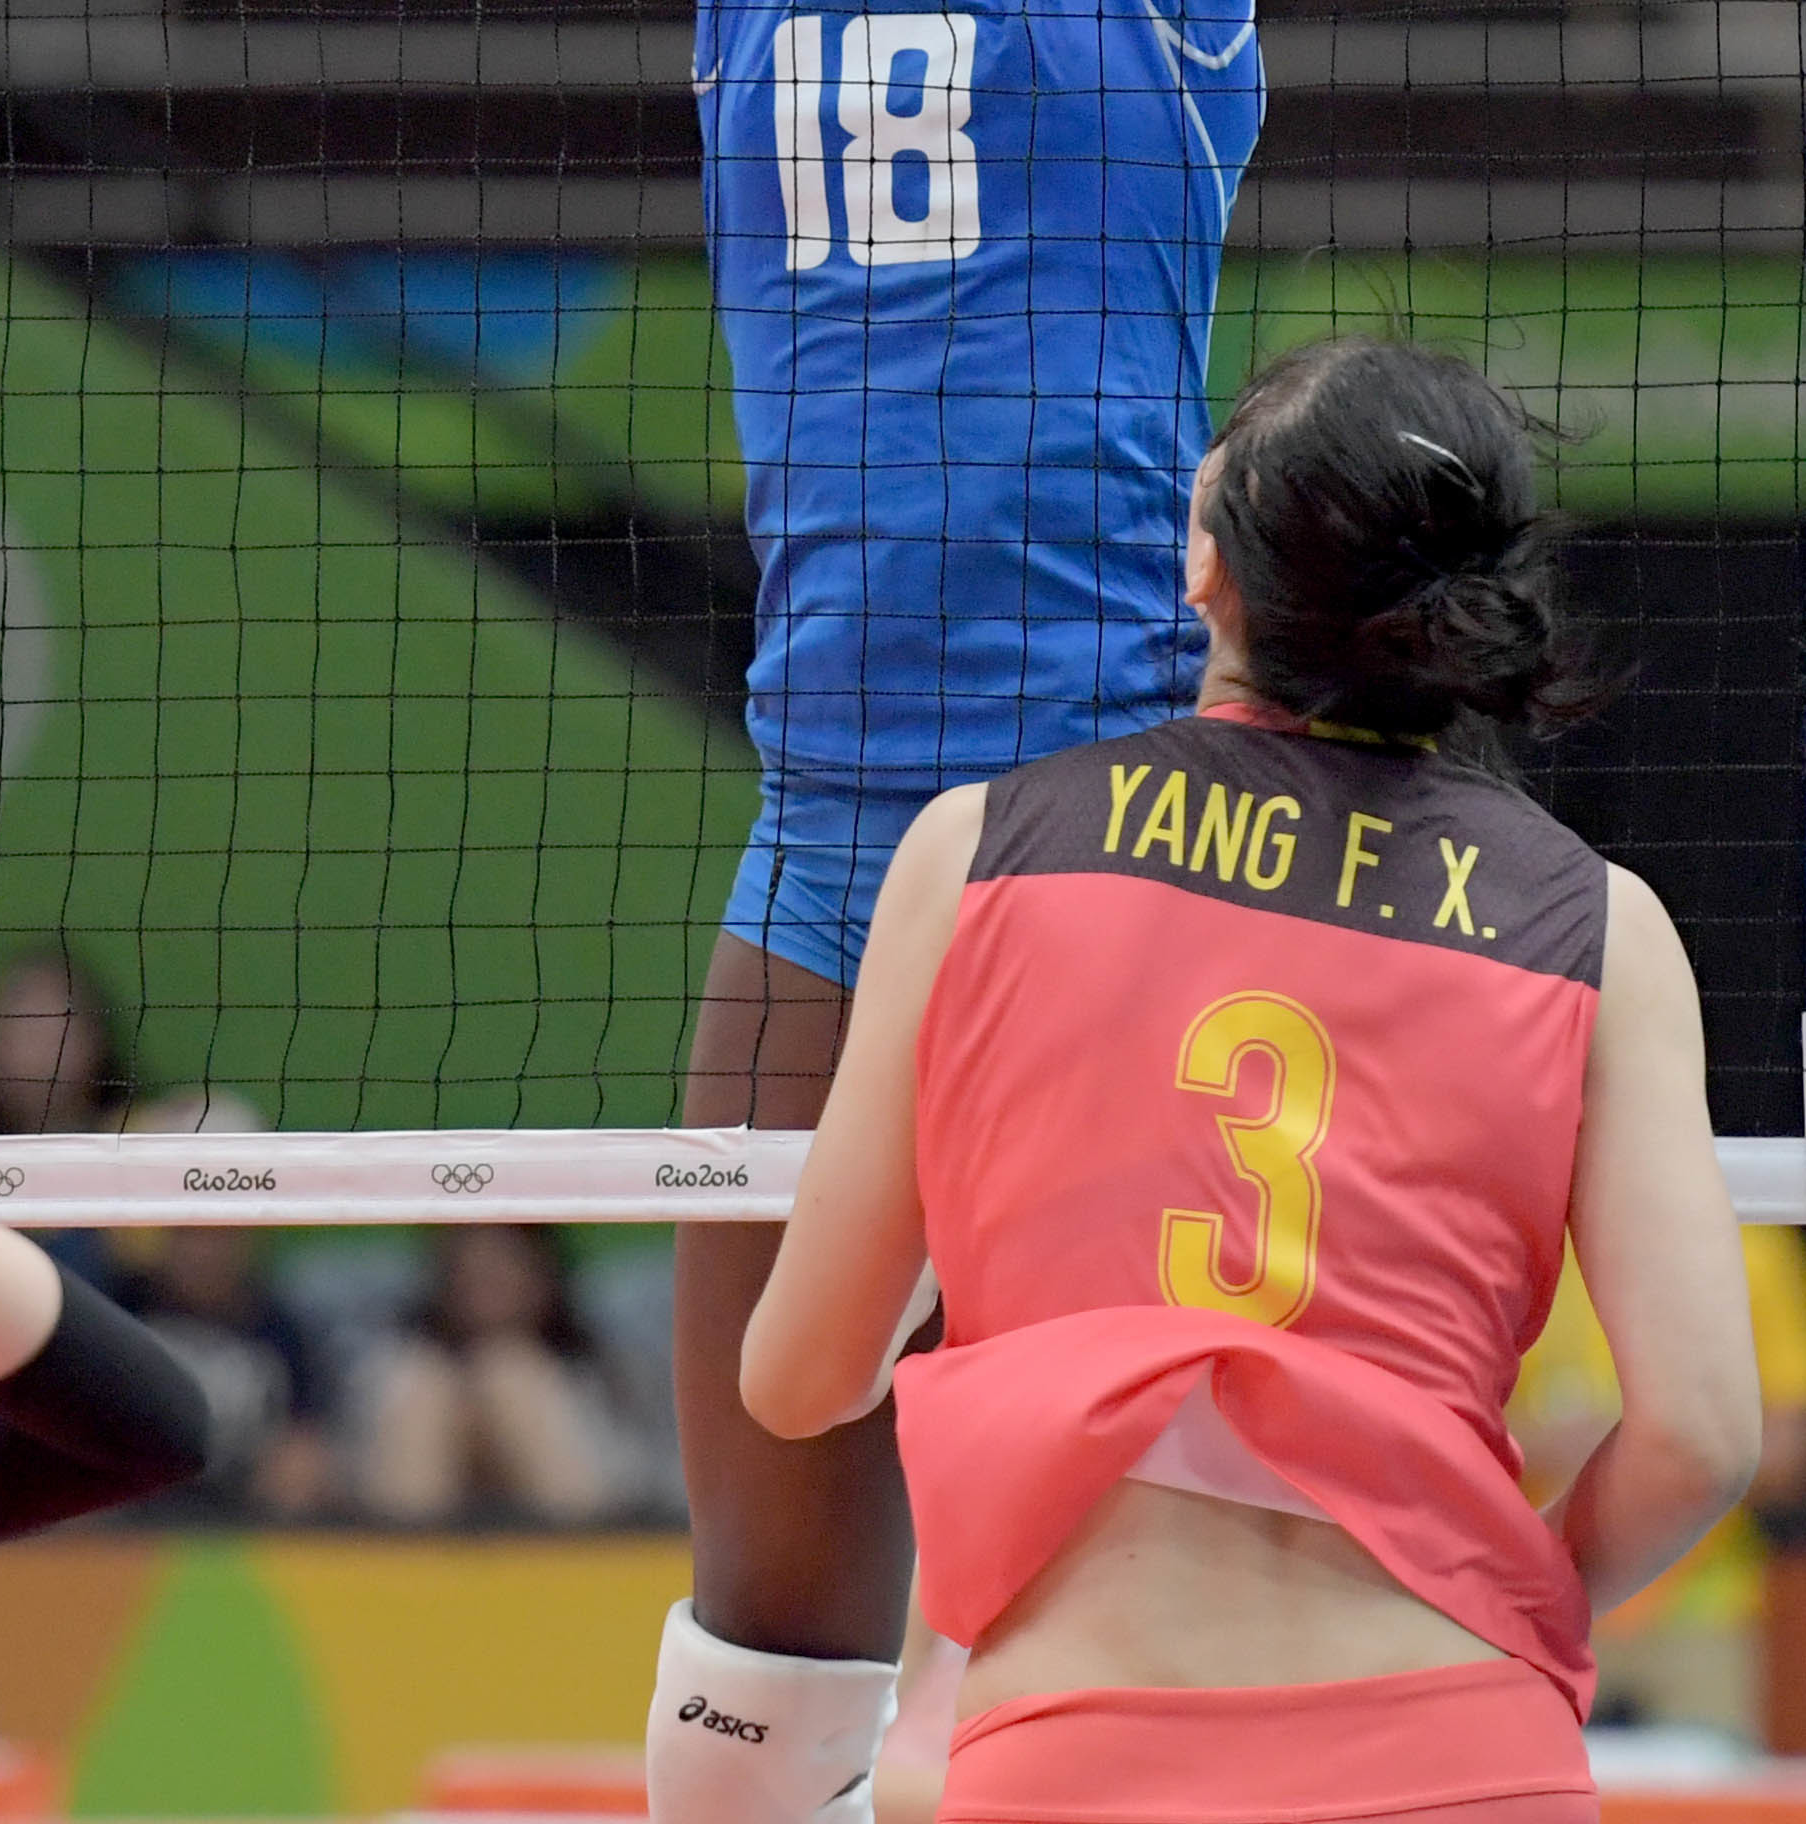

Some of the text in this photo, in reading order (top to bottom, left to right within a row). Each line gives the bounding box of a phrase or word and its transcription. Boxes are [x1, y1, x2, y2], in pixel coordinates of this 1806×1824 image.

[773, 12, 981, 272] 18
[1103, 764, 1497, 939] YANG F. X.
[183, 1167, 276, 1192] Rio2016
[655, 1163, 749, 1189] Rio2016
[1157, 989, 1337, 1332] 3
[702, 1709, 769, 1744] asics
